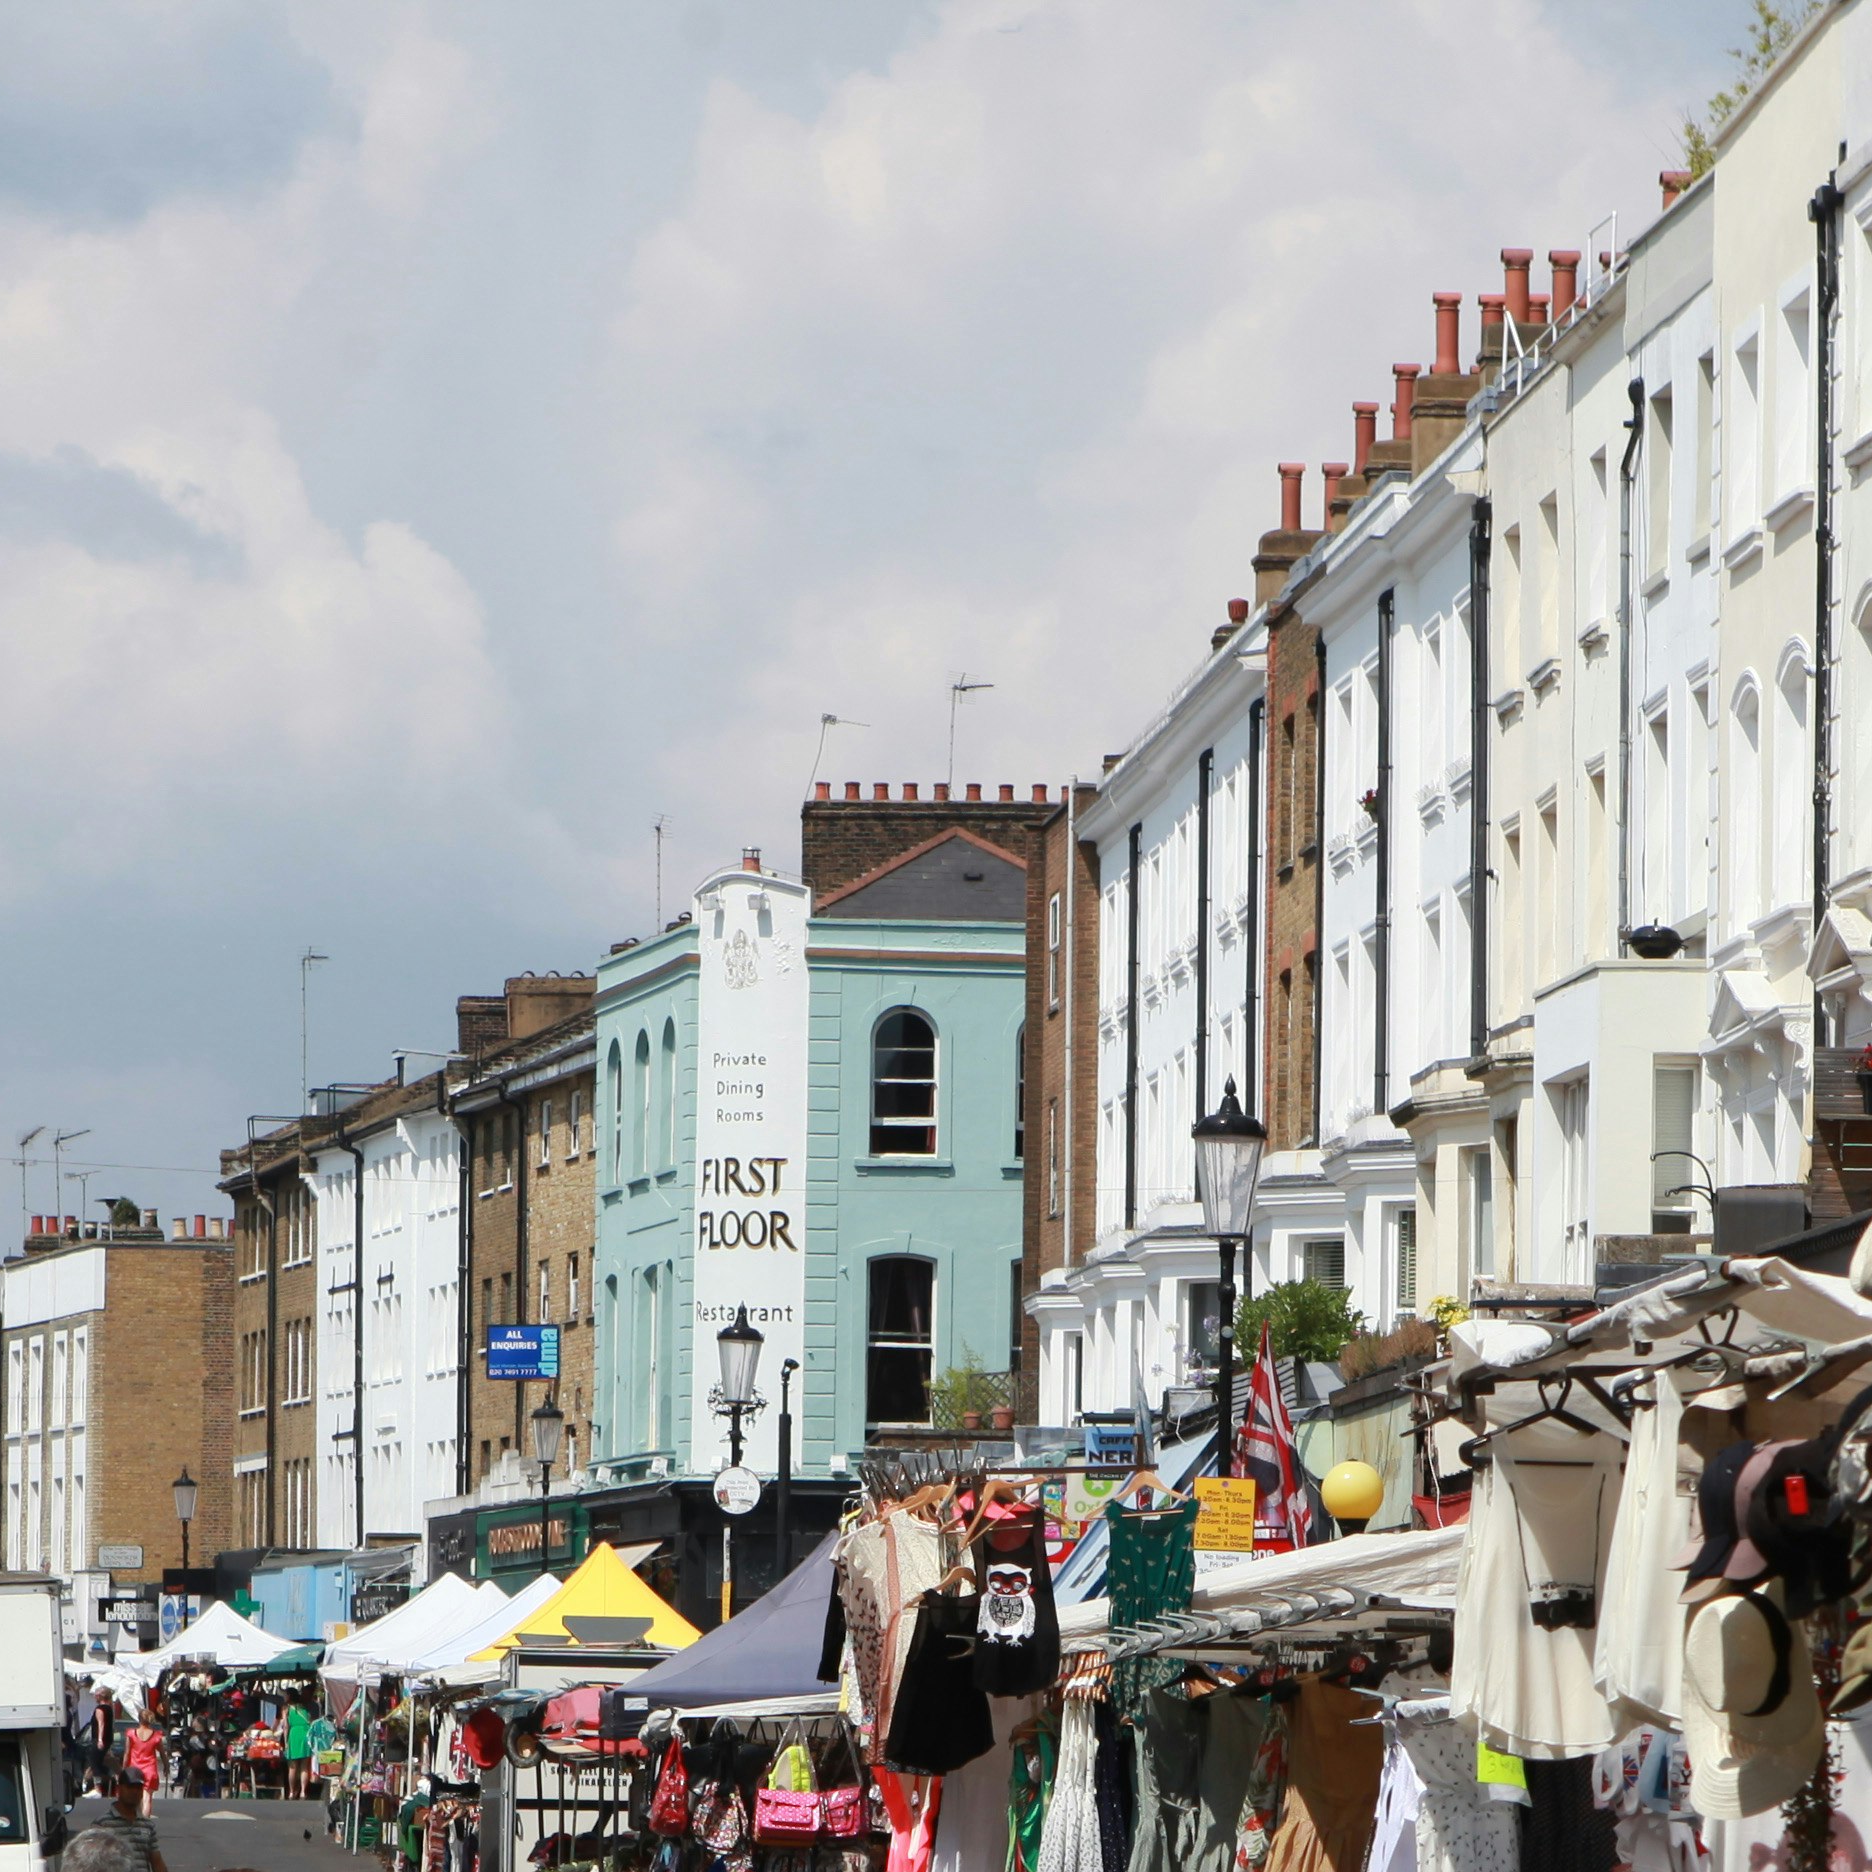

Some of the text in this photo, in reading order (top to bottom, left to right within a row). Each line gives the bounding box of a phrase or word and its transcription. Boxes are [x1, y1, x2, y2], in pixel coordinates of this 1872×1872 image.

[713, 1053, 767, 1068] Private
[717, 1081, 764, 1098] Dining
[716, 1109, 764, 1122] Rooms
[701, 1157, 788, 1198] FIRST
[699, 1210, 799, 1252] FLOOR
[696, 1301, 794, 1323] Restarant
[506, 1330, 523, 1339] ALL
[491, 1341, 538, 1351] ENQUIRIES
